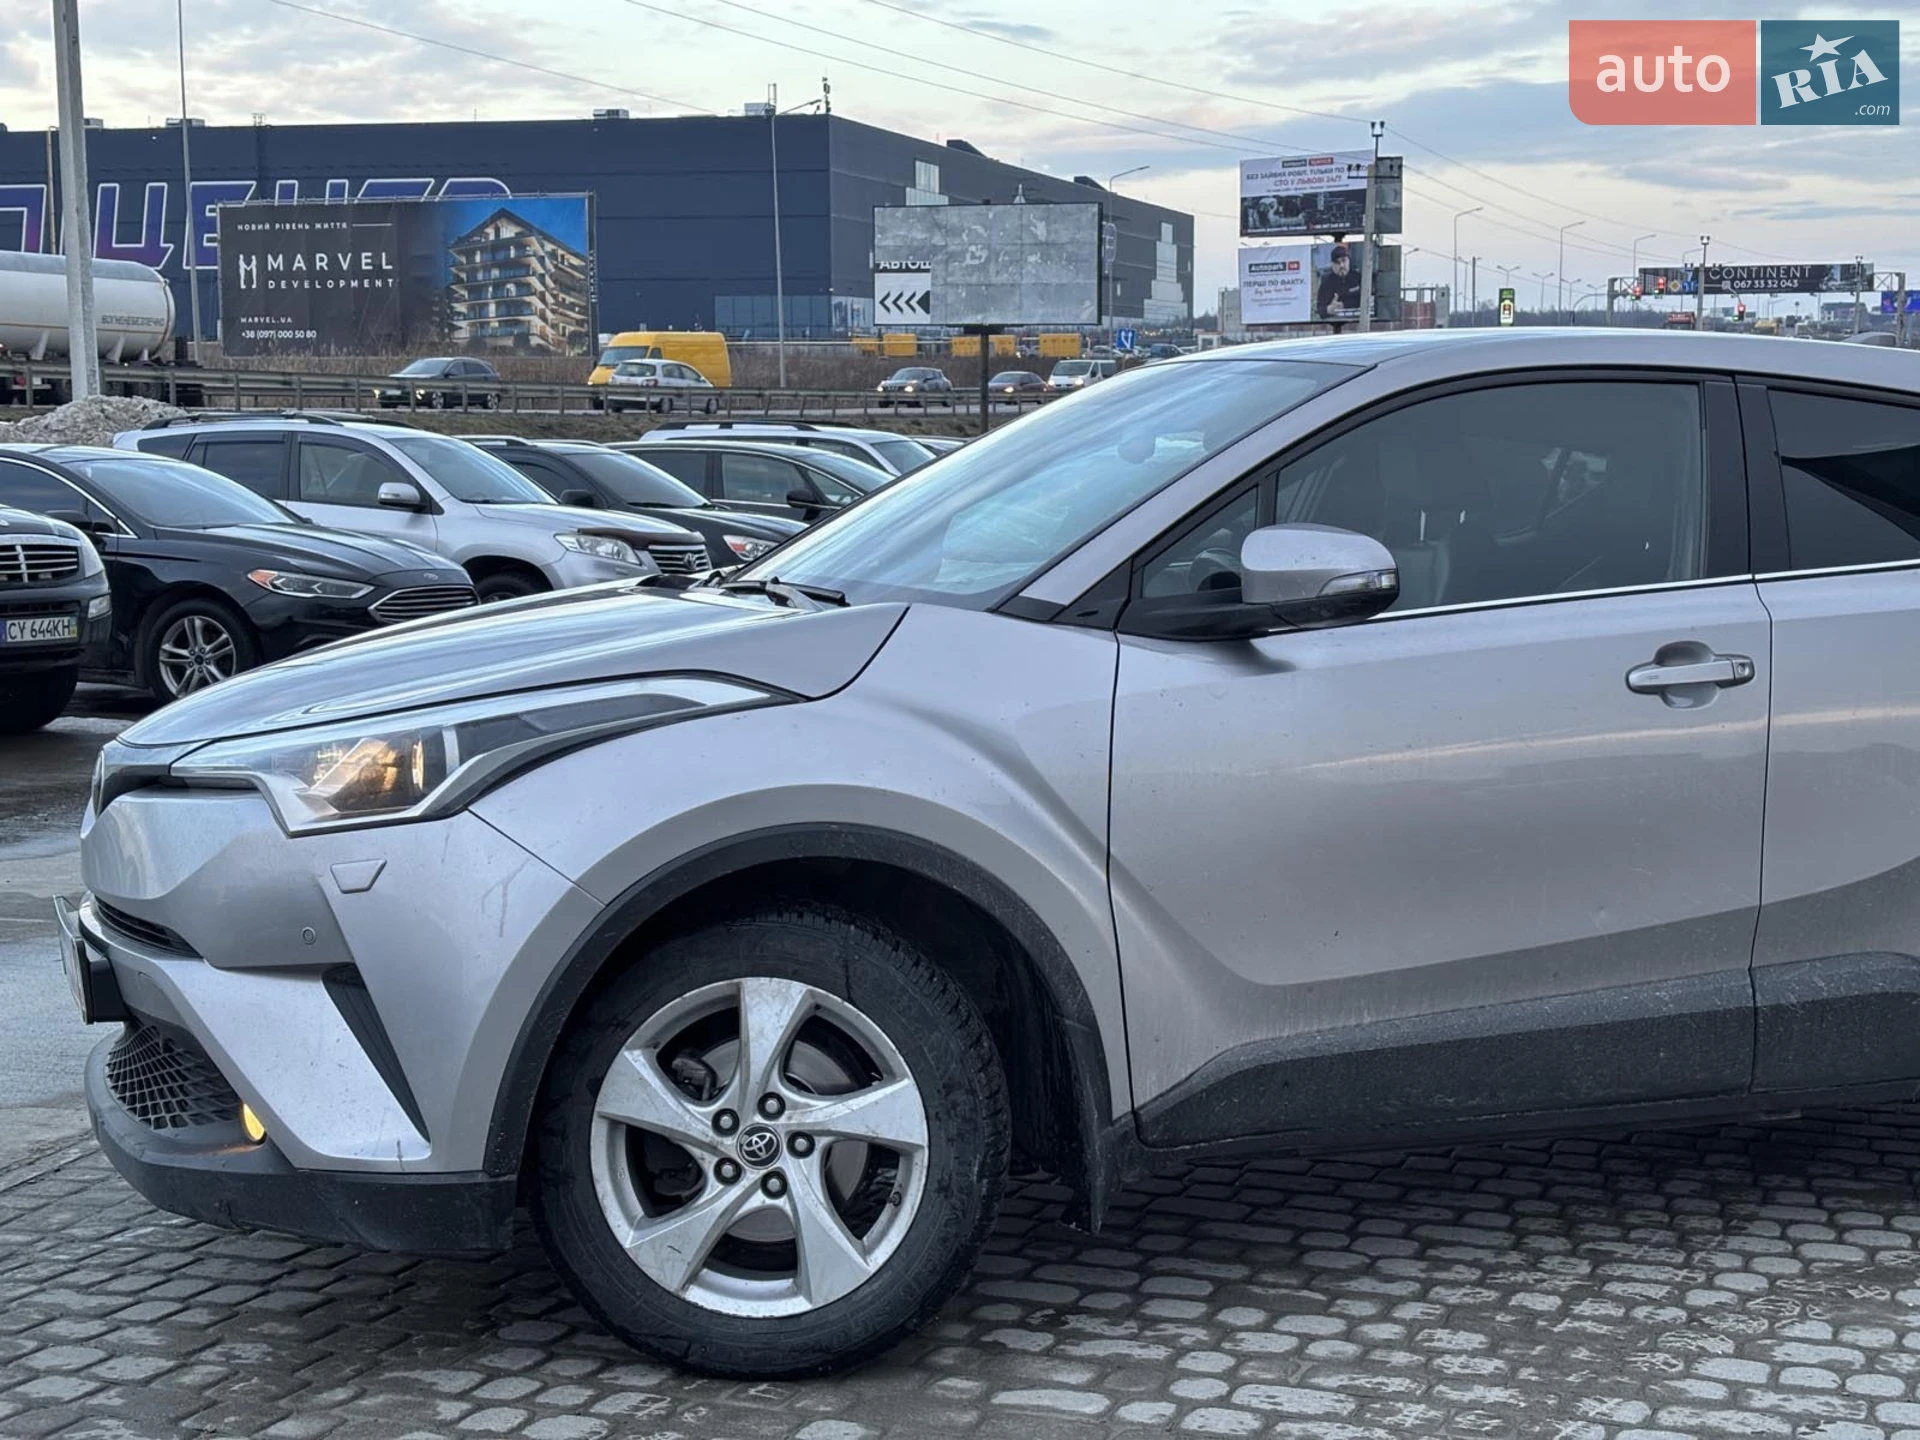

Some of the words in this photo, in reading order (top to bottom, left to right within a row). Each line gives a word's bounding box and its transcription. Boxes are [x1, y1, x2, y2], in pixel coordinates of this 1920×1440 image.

[238, 222, 270, 231] НОВИЙ
[275, 222, 310, 230] РІВЕНЬ
[315, 221, 348, 229] ЖИТТЯ
[267, 252, 393, 271] MARVEL
[1709, 265, 1812, 280] CONTINENT
[268, 278, 394, 289] DEVELOPMENT
[1733, 280, 1752, 289] 067
[1753, 280, 1765, 288] 33
[1767, 280, 1779, 288] 32
[1780, 279, 1799, 288] 043
[240, 316, 293, 324] MARVEL.UA
[241, 331, 255, 339] +38
[256, 330, 276, 340] (097)
[278, 330, 293, 339] 000
[294, 330, 305, 339] 50
[306, 330, 317, 339] 80
[8, 621, 26, 640] CY
[30, 619, 71, 638] 644KH
